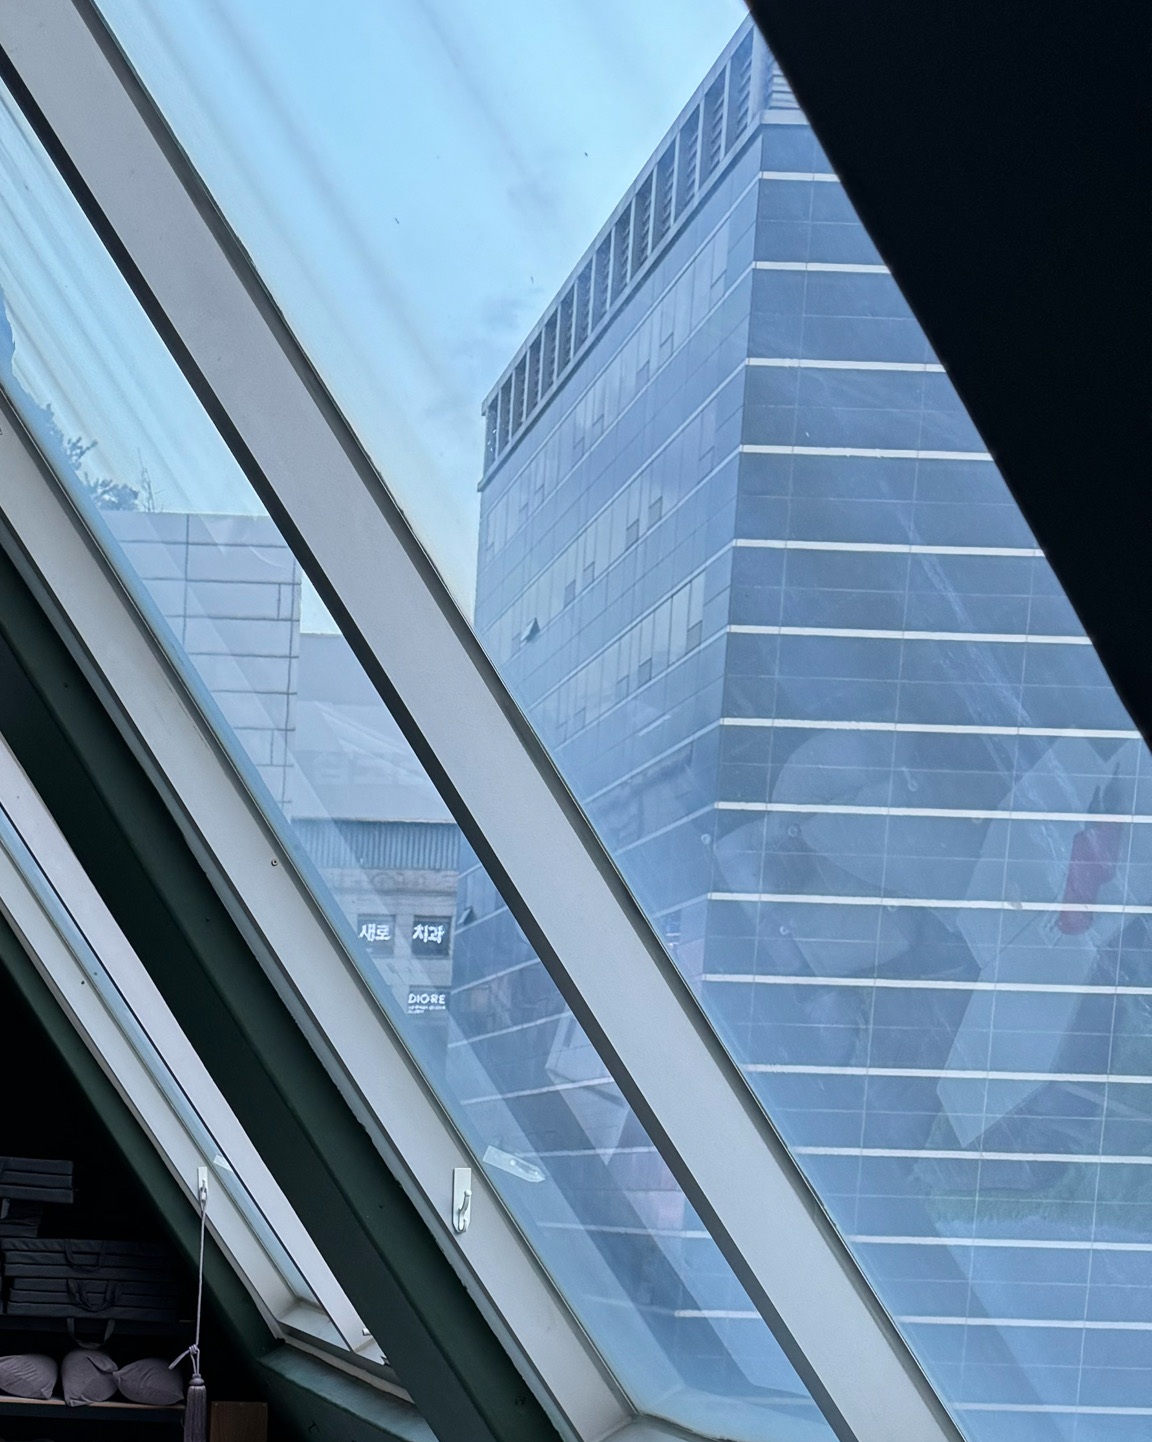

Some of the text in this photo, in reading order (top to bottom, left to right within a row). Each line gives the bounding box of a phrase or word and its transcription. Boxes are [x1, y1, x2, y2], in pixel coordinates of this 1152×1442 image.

[358, 923, 445, 943] 새로 치과
[408, 993, 446, 1004] DIORE
